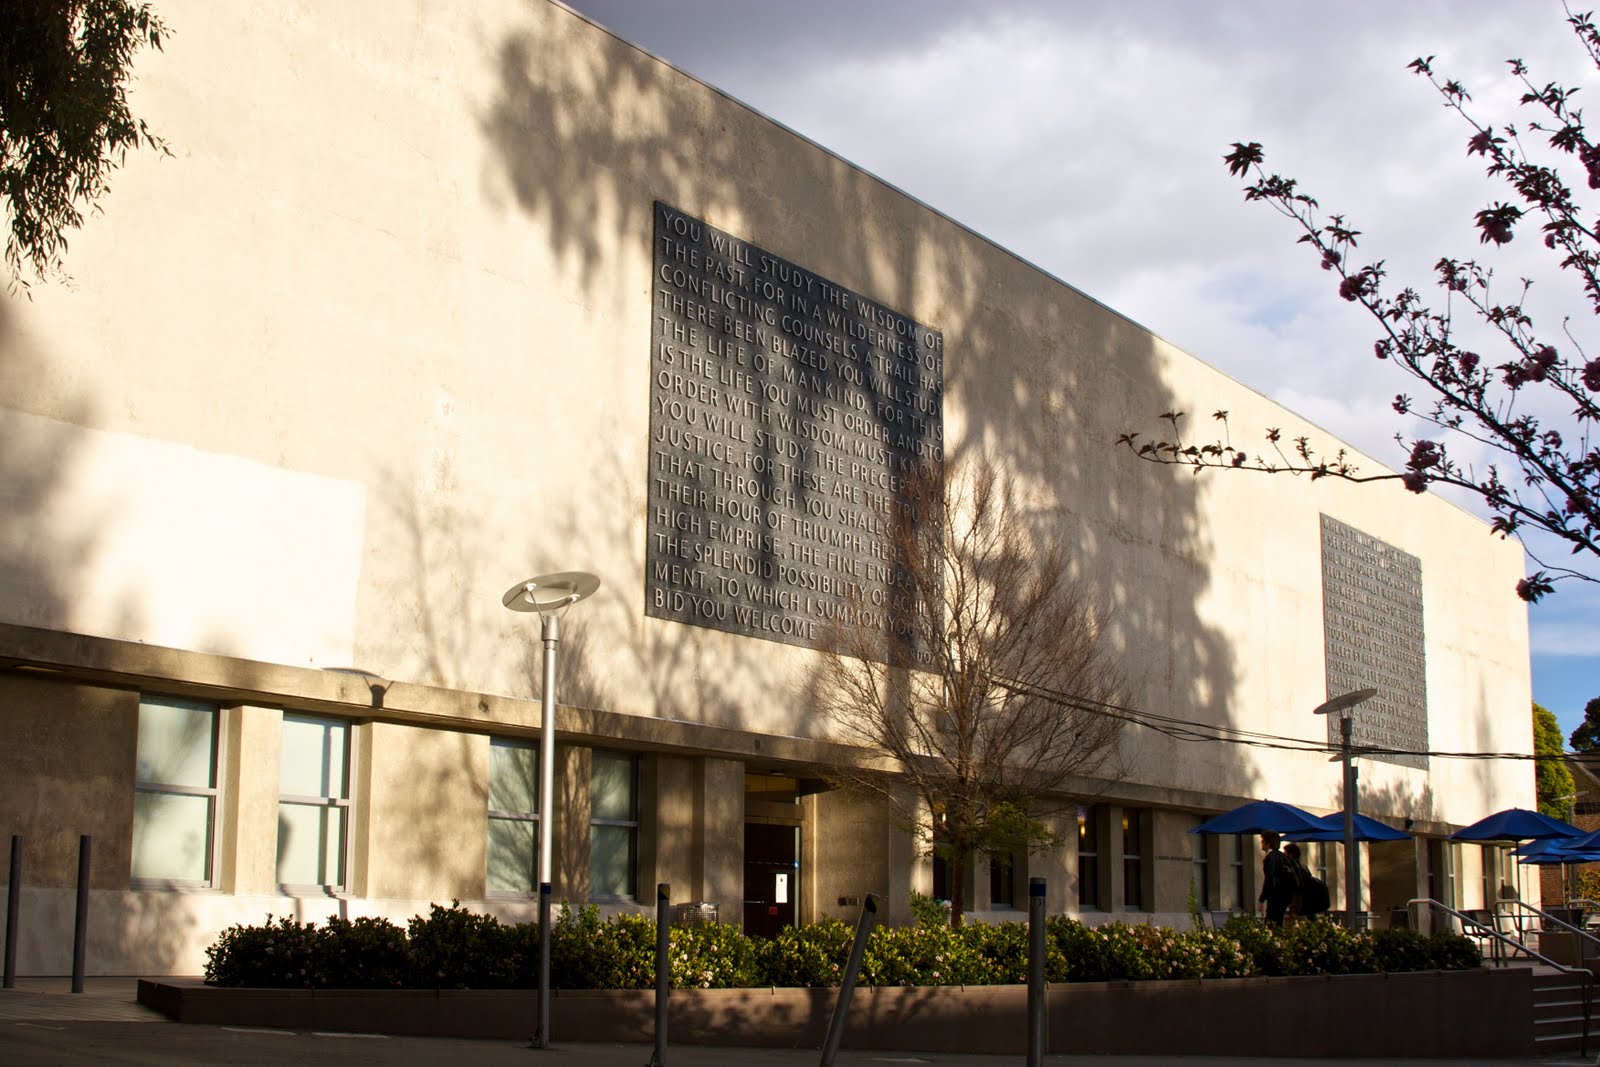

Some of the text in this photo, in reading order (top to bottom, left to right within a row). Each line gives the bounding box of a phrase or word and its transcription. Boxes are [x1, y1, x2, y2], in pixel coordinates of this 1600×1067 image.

[661, 236, 698, 269] THE
[754, 277, 784, 306] FOR
[791, 293, 806, 315] IN
[812, 302, 822, 322] A
[826, 309, 921, 365] WILDERNESS
[925, 352, 941, 374] OF
[663, 210, 941, 352] YOU WILL STUDY THE WISDOM OF
[659, 261, 775, 327] CONFLICTING
[864, 349, 873, 367] A
[875, 353, 914, 384] TRAIL
[919, 372, 942, 396] HAS
[659, 288, 716, 328] THERE
[723, 314, 765, 348] BEEN
[835, 360, 863, 387] YOU
[868, 374, 901, 402] WILL
[904, 388, 942, 418] STUDY
[657, 368, 718, 407] ORDER
[724, 392, 771, 425] WITH
[853, 438, 894, 468] MUST
[658, 341, 674, 365] IS
[678, 349, 713, 379] THE
[719, 364, 753, 394] LIFE
[758, 379, 790, 407] YOU
[796, 393, 839, 425] MUST
[926, 442, 943, 463] TO
[659, 315, 697, 347] THE
[707, 334, 745, 365] LIFE
[753, 352, 776, 377] OF
[877, 400, 903, 426] FOR
[909, 413, 942, 441] THIS
[657, 395, 696, 426] YOU
[703, 411, 747, 443] WILL
[755, 429, 808, 463] STUDY
[815, 449, 845, 475] THE
[655, 477, 708, 510] THEIR
[714, 494, 761, 525] HOUR
[766, 509, 787, 532] OF
[656, 450, 705, 482] THAT
[710, 466, 796, 509] THROUGH
[802, 495, 833, 520] YOU
[838, 505, 881, 534] SHALL
[744, 451, 774, 477] FOR
[780, 462, 827, 494] THESE
[831, 479, 859, 504] ARE
[863, 489, 891, 514] THE
[654, 532, 689, 559] THE
[692, 542, 773, 579] SPLENDID
[777, 563, 866, 602] POSSIBILITY
[871, 587, 888, 608] OF
[655, 505, 701, 535] HIGH
[790, 541, 821, 566] THE
[826, 551, 861, 577] FINE
[654, 588, 817, 640] BID YOU WELCOME
[717, 575, 740, 598] TO
[746, 582, 799, 611] WHICH
[806, 596, 810, 614] I
